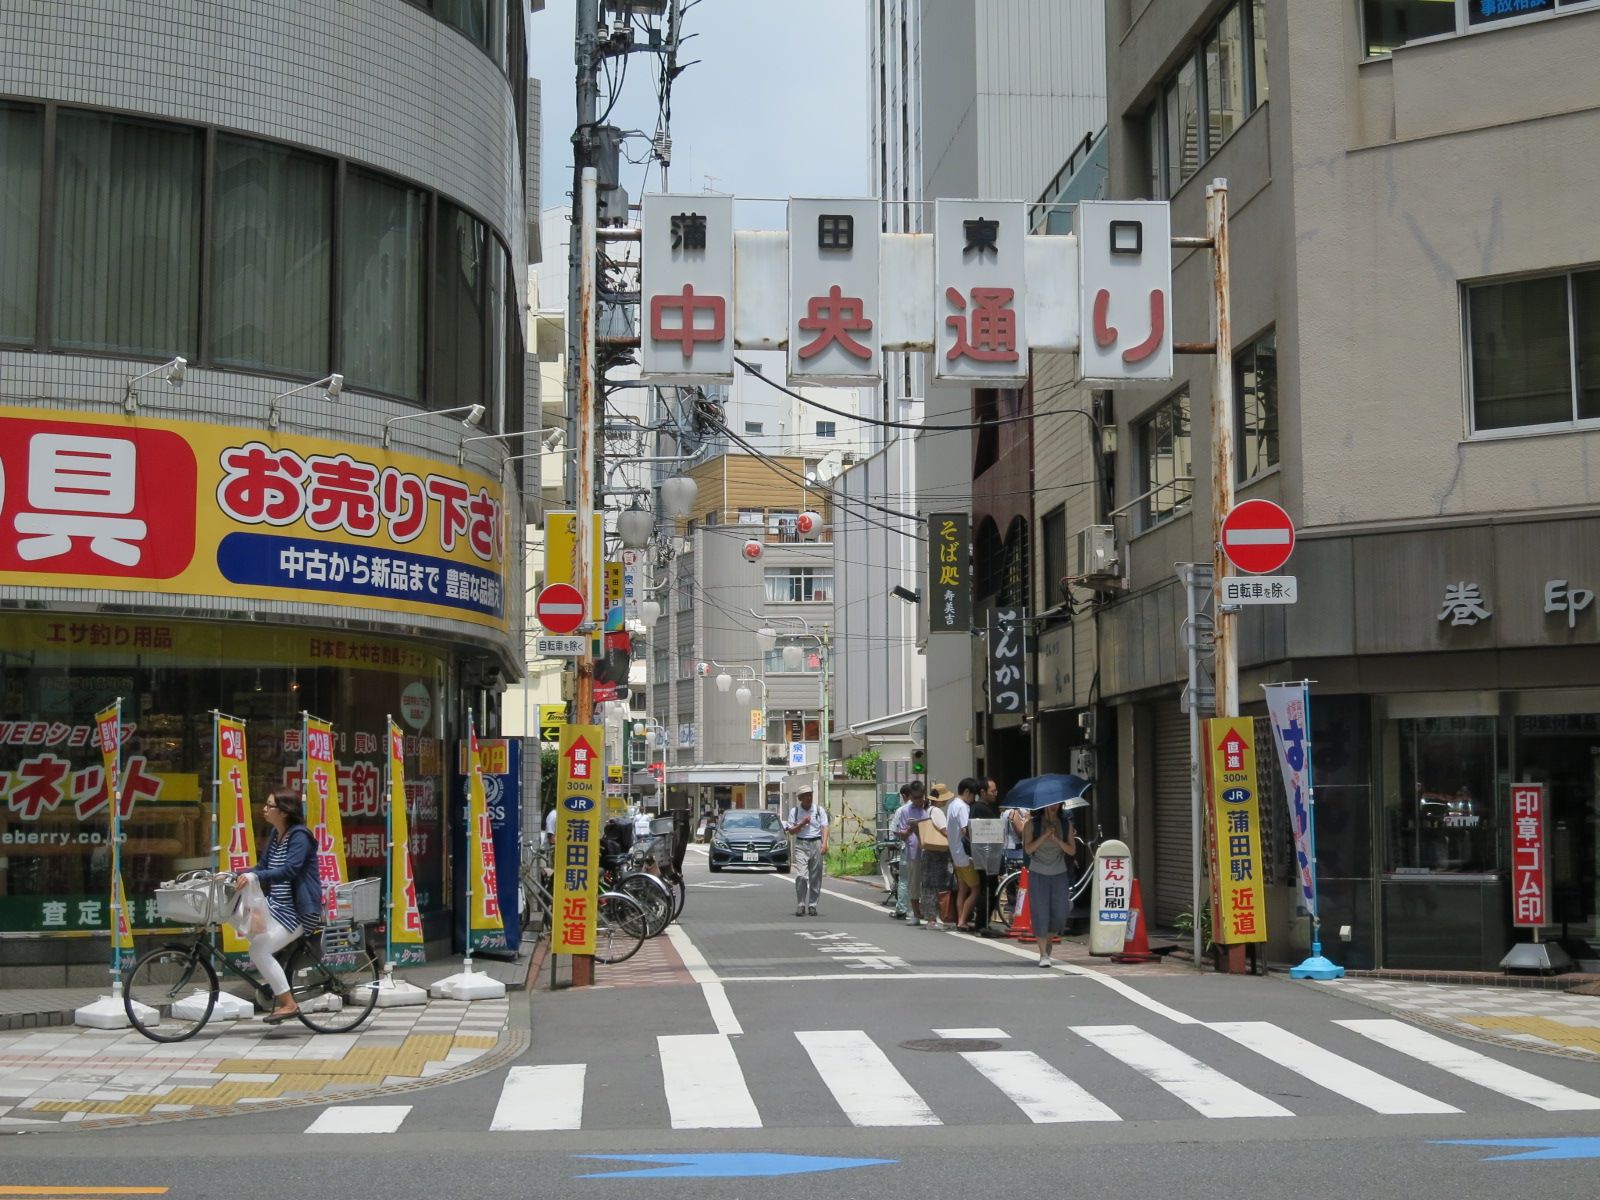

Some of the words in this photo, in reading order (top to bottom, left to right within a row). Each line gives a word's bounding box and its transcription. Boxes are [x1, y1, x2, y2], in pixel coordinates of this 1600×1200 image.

[671, 212, 1142, 256] 蒲田東口
[651, 283, 1163, 362] 中央通り
[940, 521, 960, 585] そば処
[280, 546, 439, 594] 中古から新品まで
[1228, 583, 1292, 599] 自転車を除く
[47, 623, 173, 649] エサ釣り用品
[539, 640, 583, 652] 自転車を除く
[462, 744, 507, 774] 10円
[574, 748, 588, 776] 直進
[1227, 740, 1240, 769] 直進
[567, 781, 593, 791] 300M
[1223, 773, 1248, 782] 300M
[570, 799, 587, 809] JR
[1229, 790, 1244, 800] JR
[565, 819, 590, 891] 蒲田駅
[1227, 810, 1253, 882] 蒲田駅
[563, 898, 587, 946] 近道
[1231, 887, 1256, 935] 近道
